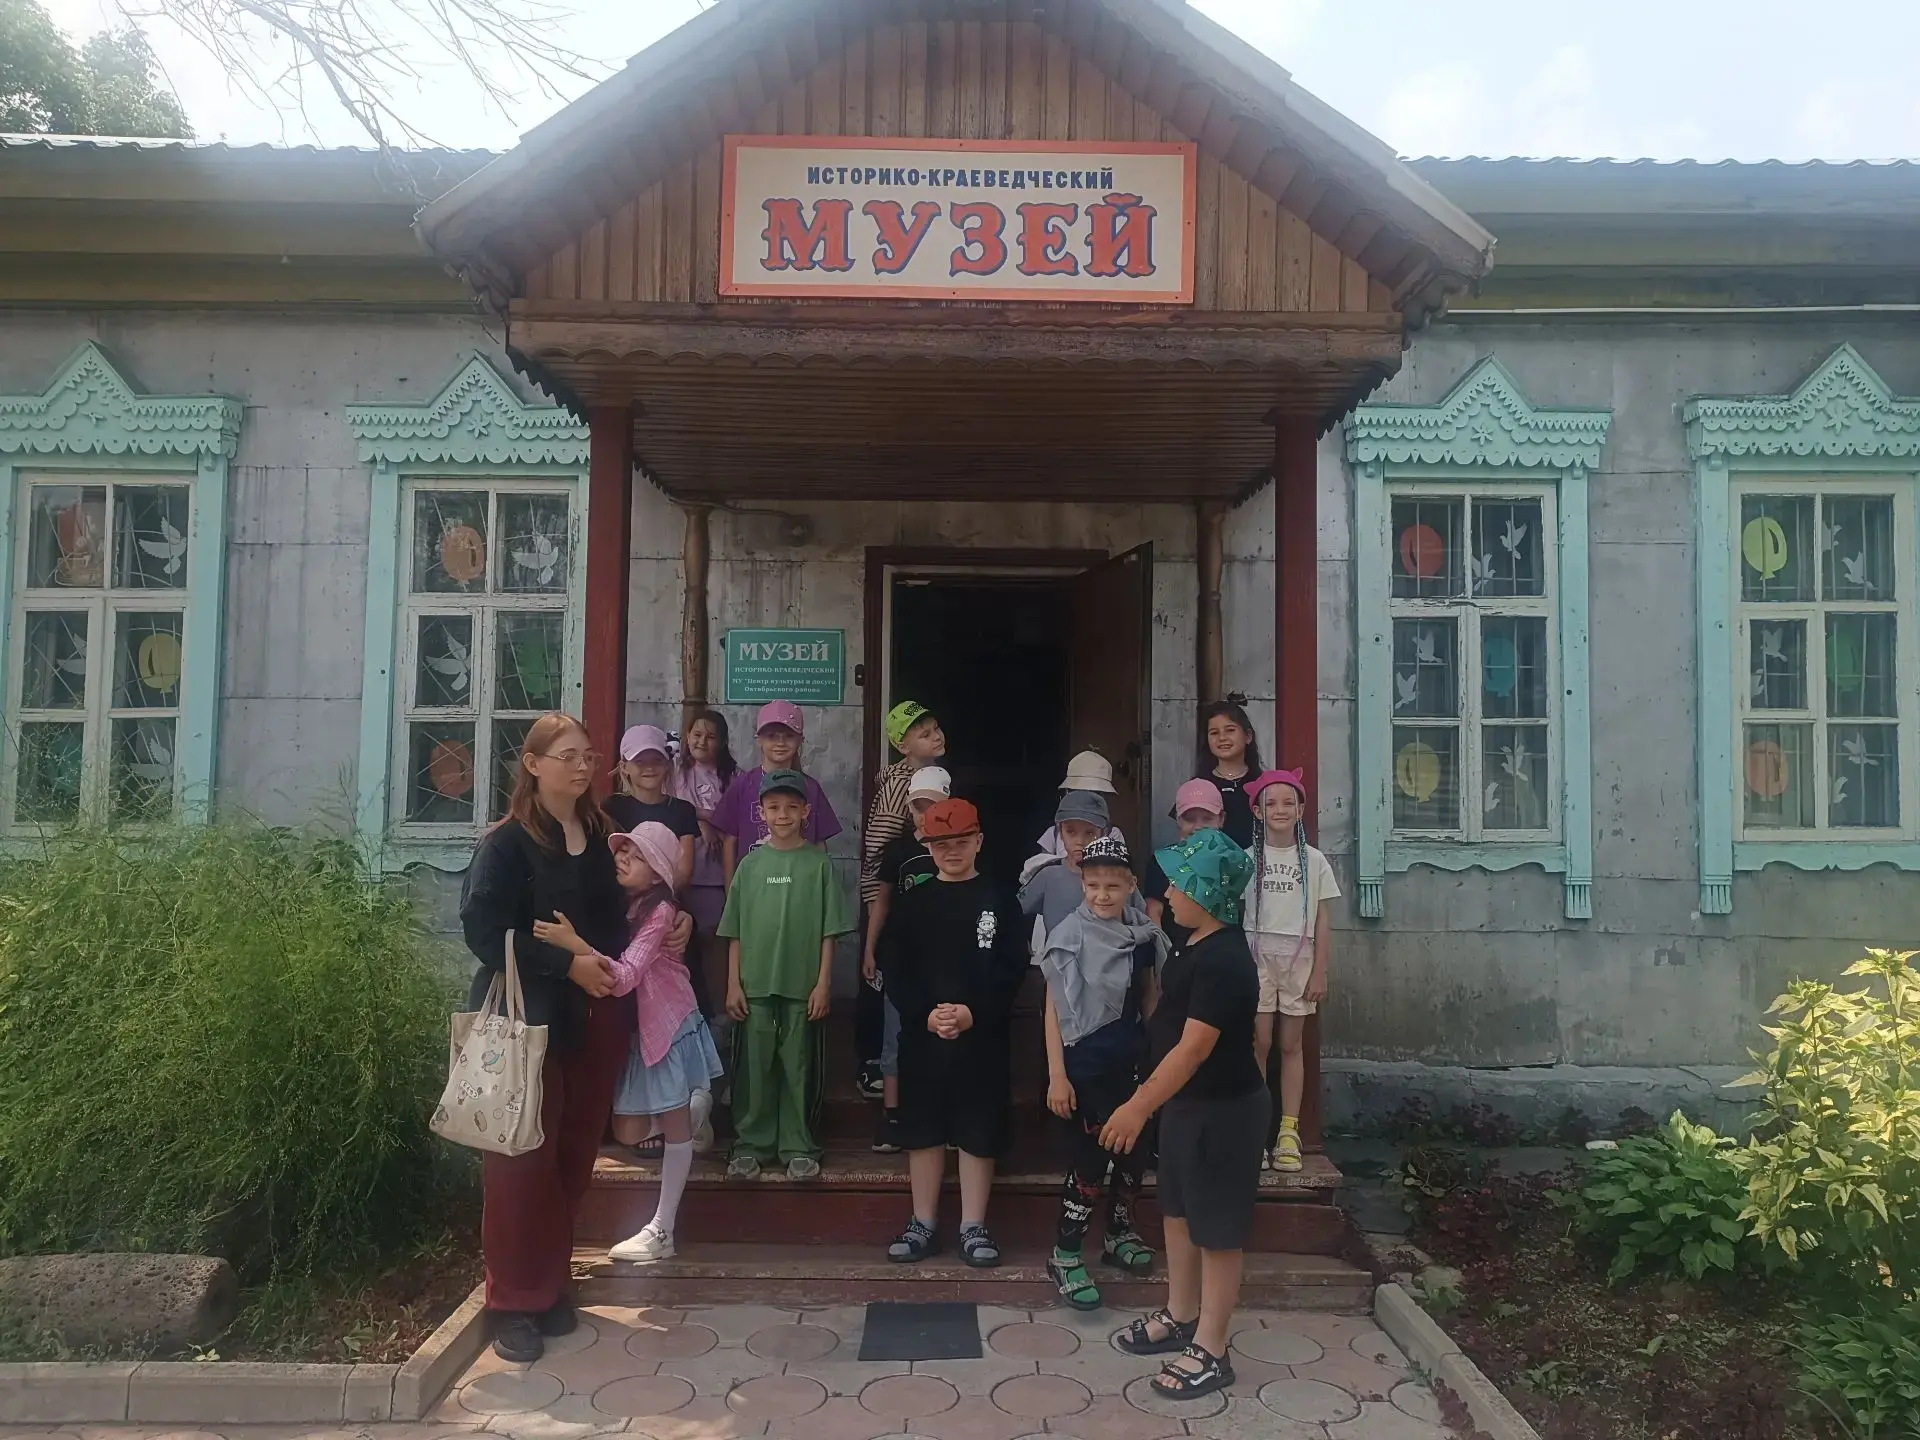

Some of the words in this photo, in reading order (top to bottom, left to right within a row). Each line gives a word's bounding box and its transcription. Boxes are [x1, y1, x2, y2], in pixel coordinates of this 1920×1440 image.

[807, 165, 1113, 190] ИСТОРИКО-КРАЕВЕДЧЕСКИЙ
[760, 193, 1158, 279] МУЗЕЙ
[739, 640, 829, 661] МУЗЕЙ
[1263, 880, 1294, 891] STATE
